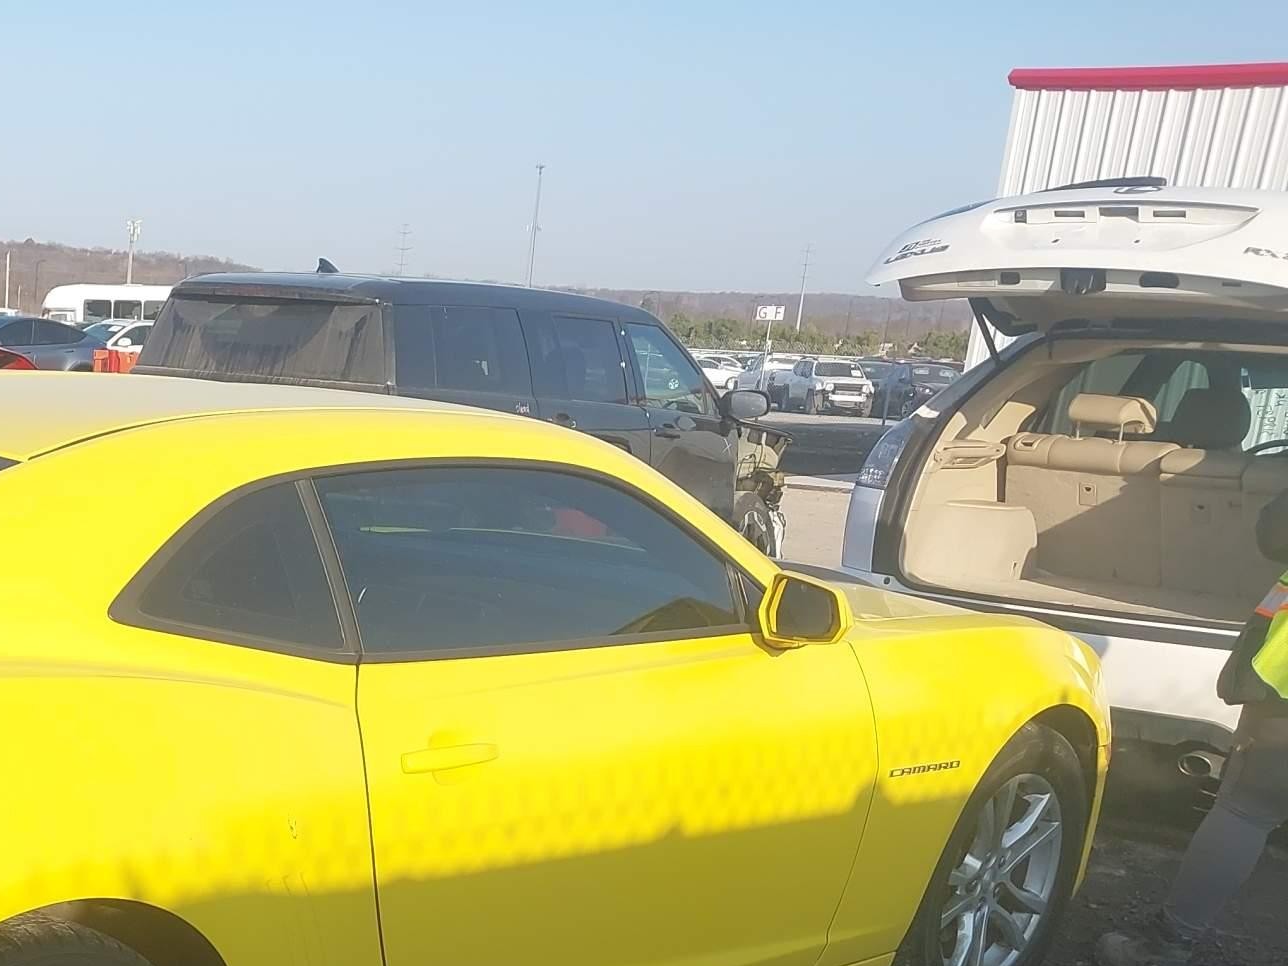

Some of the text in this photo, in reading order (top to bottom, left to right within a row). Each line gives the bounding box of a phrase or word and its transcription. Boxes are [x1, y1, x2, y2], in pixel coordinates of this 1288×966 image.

[758, 306, 783, 320] G F
[889, 760, 961, 778] CAMARO
